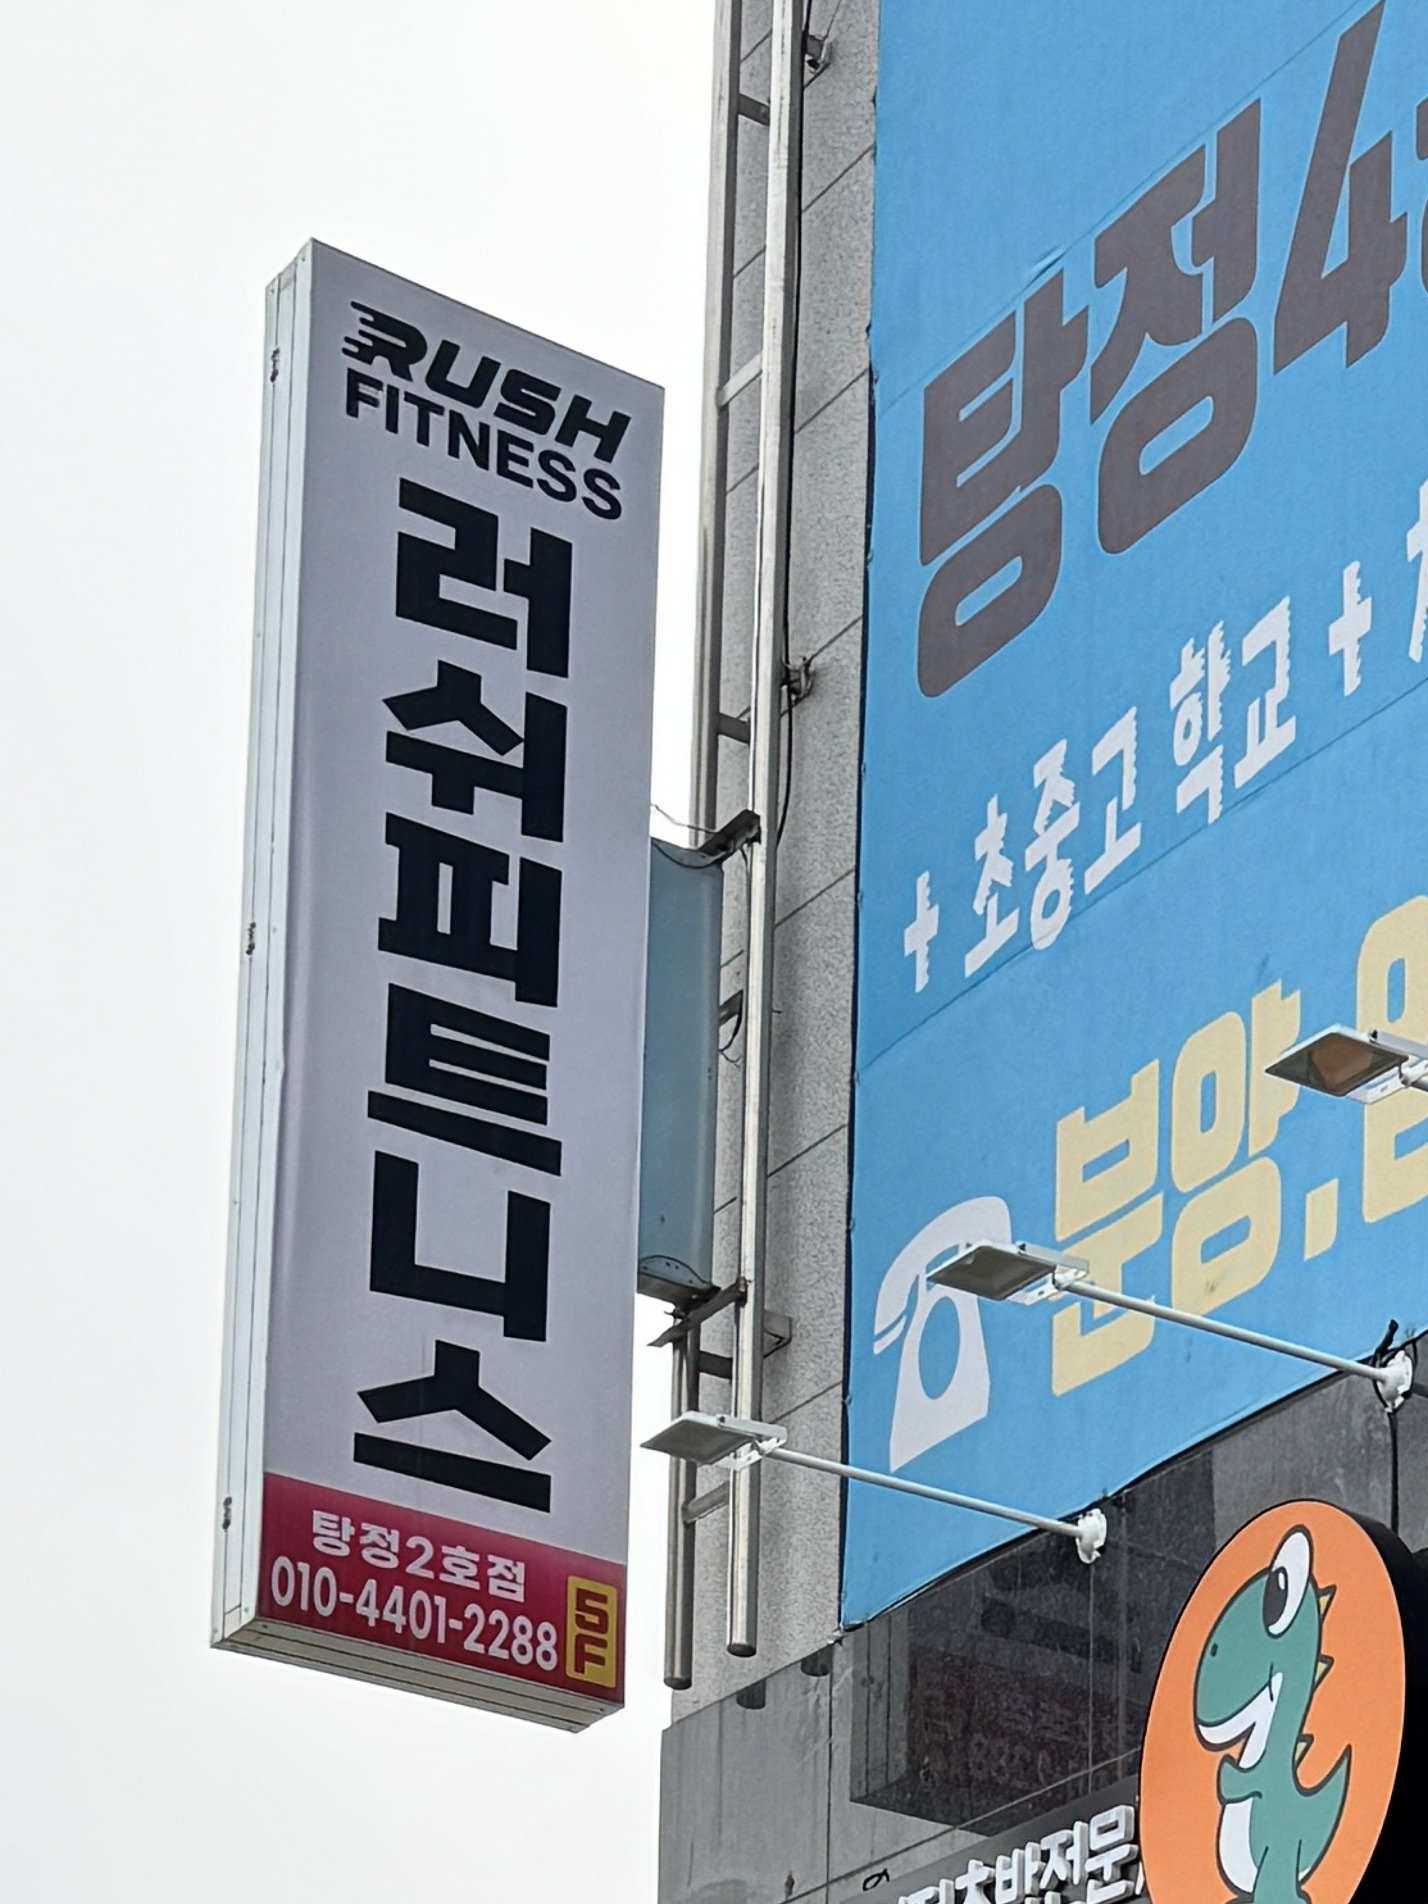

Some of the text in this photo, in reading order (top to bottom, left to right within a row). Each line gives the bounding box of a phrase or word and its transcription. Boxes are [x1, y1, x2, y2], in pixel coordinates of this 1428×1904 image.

[341, 301, 632, 462] RUSH
[344, 366, 624, 520] FITNESS
[965, 707, 1142, 980] 초중고
[1168, 596, 1297, 825] 학교
[353, 477, 572, 1514] 러쉬피트니스
[268, 1554, 560, 1673] 010-4401-2288
[309, 1507, 526, 1603] 탕정2호점
